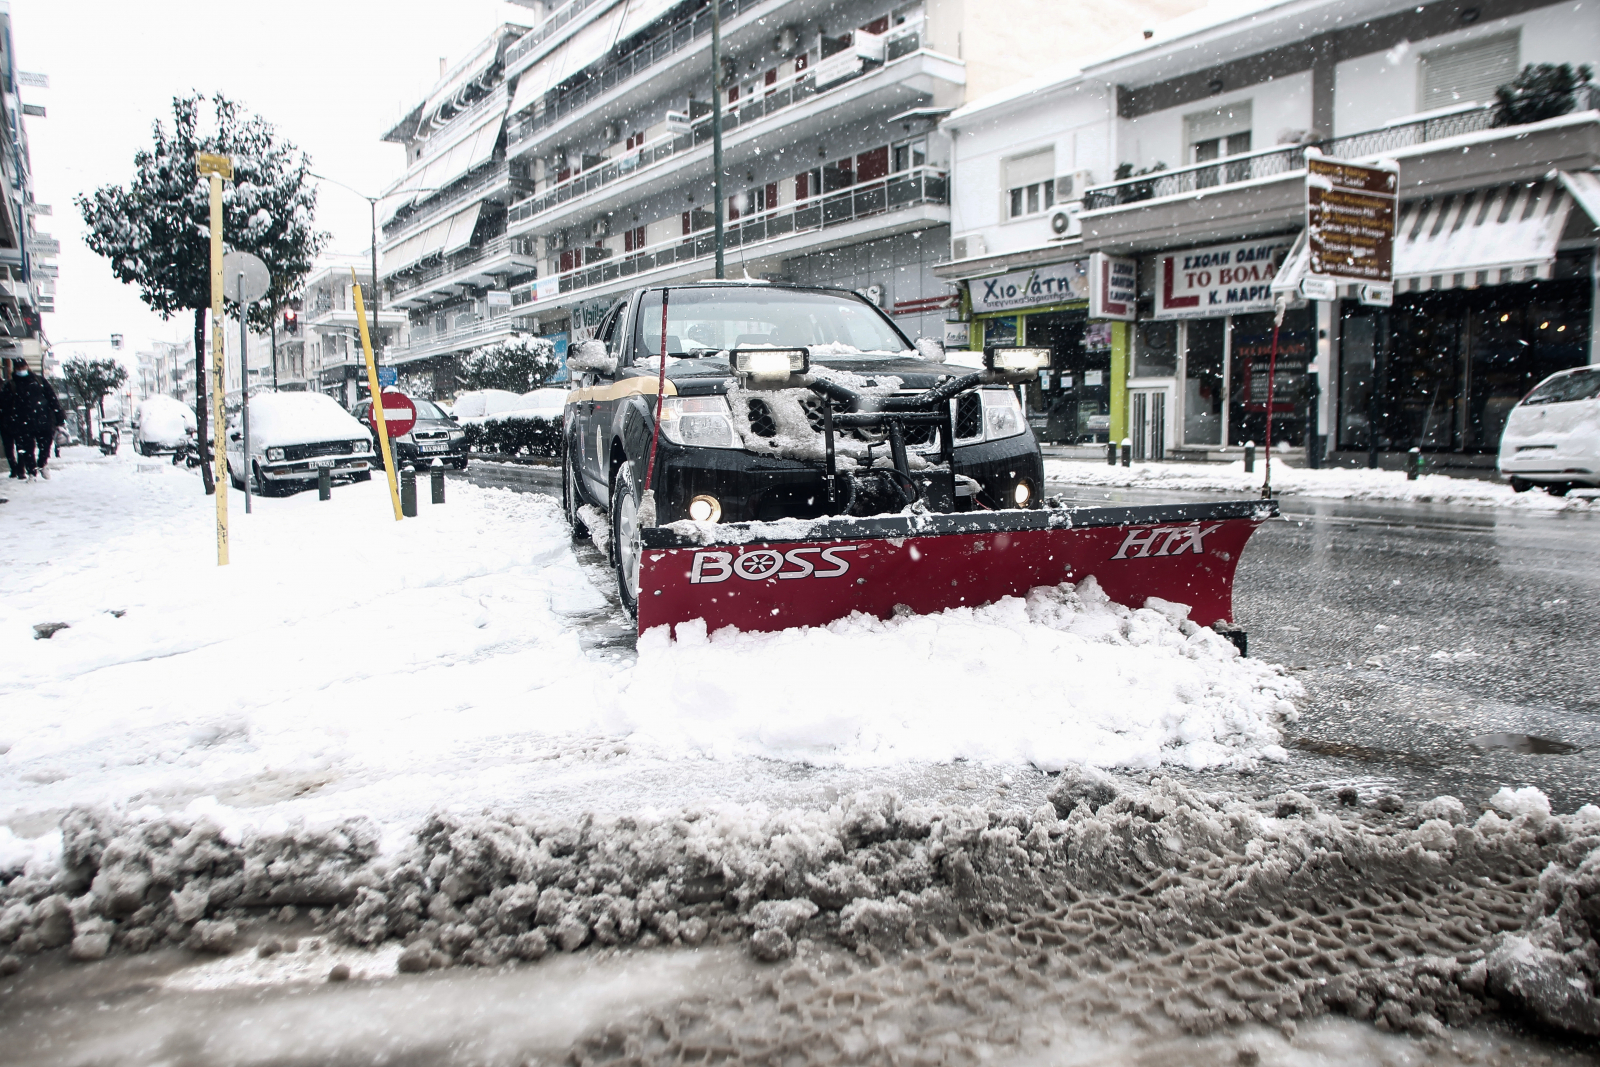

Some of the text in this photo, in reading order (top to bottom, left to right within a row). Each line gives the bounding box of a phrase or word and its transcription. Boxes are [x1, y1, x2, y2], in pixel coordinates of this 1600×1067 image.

[1183, 243, 1292, 270] ΣΧΟΛΗ ΟΔΗΓ
[1185, 263, 1276, 289] ΤΟ ΒΟΛΑ
[1109, 523, 1226, 560] HTX
[690, 545, 858, 584] BOSS
